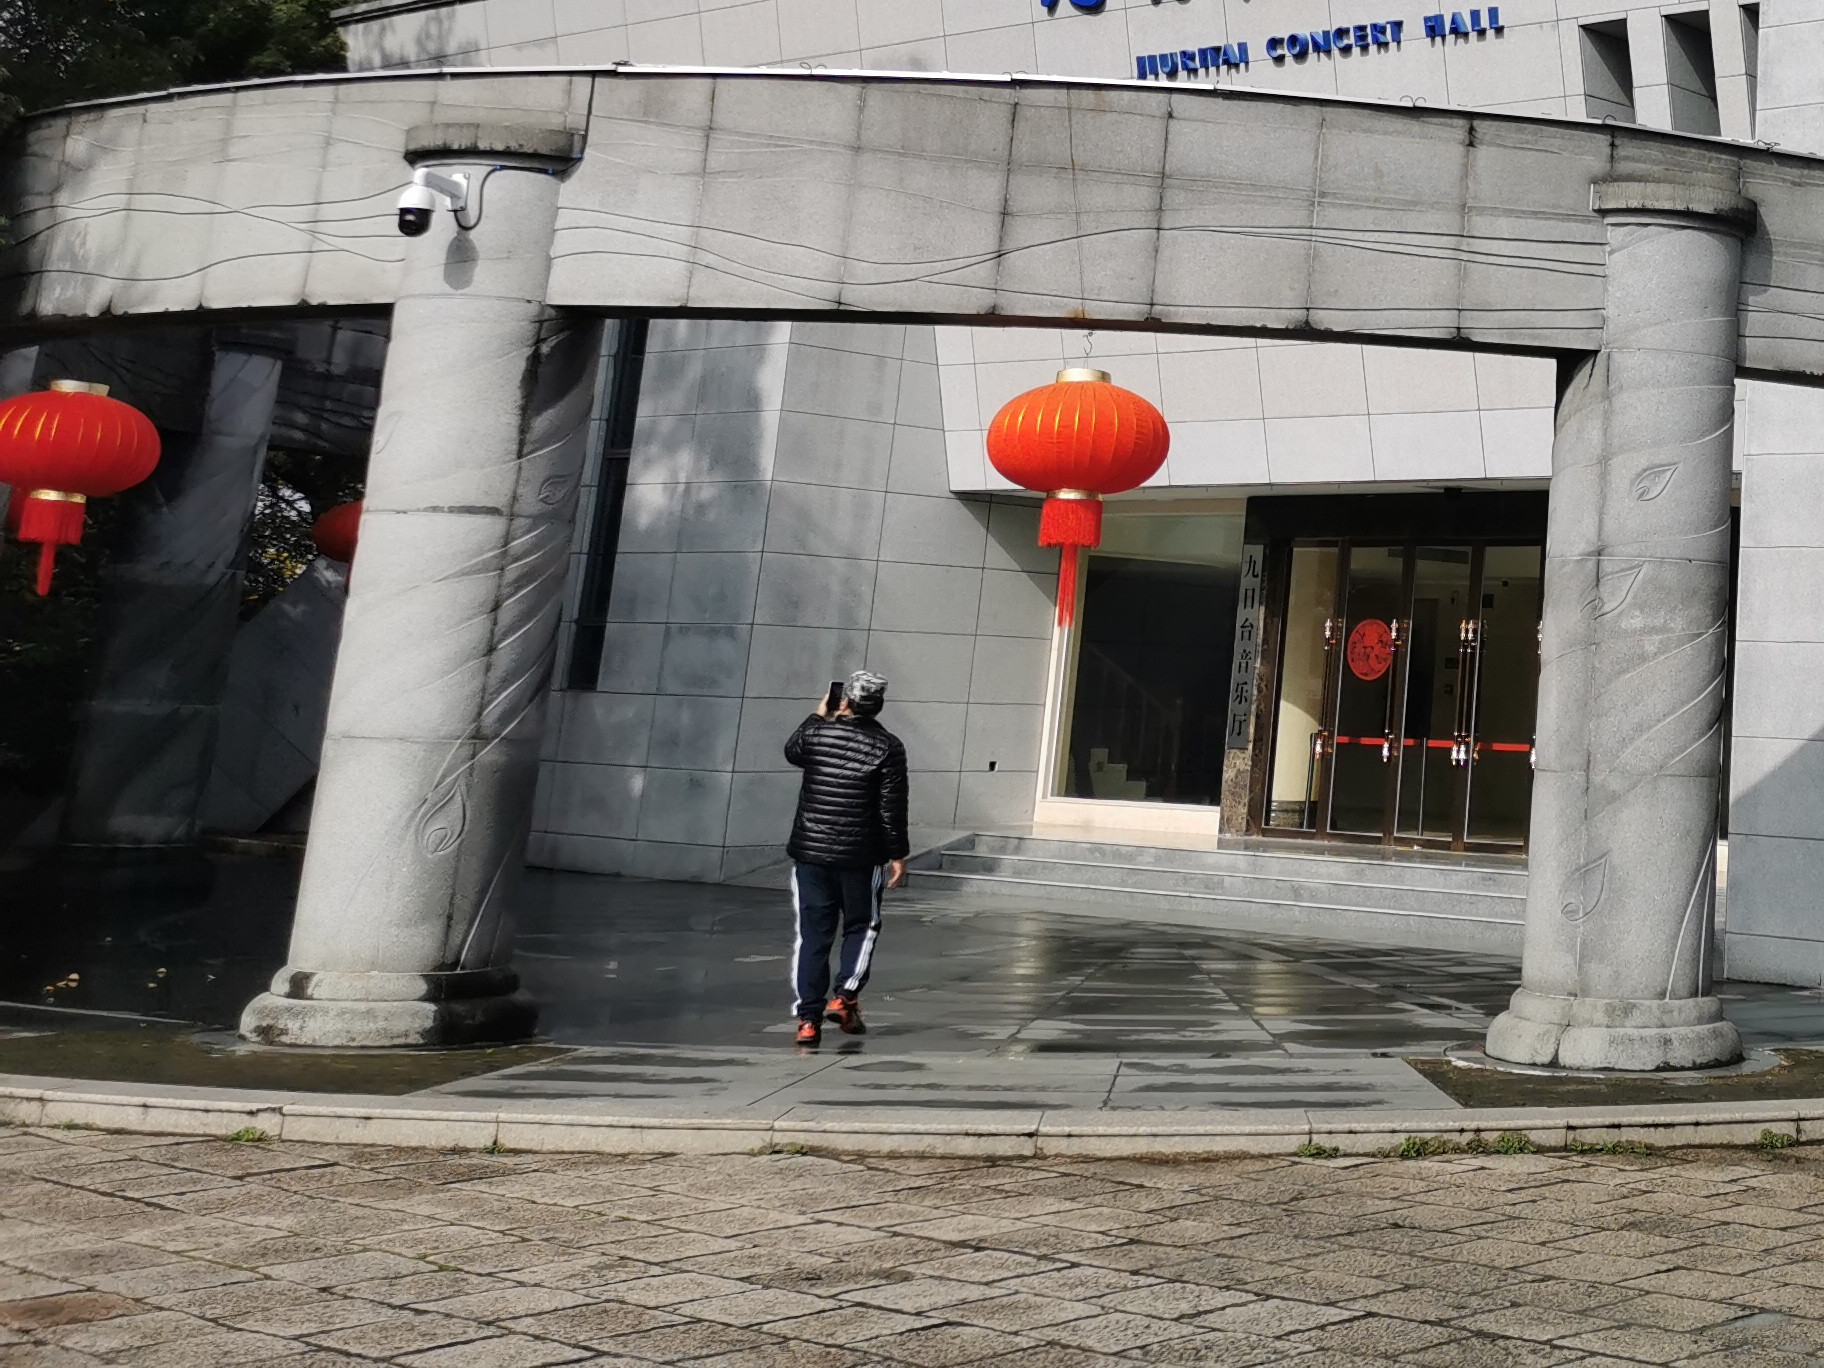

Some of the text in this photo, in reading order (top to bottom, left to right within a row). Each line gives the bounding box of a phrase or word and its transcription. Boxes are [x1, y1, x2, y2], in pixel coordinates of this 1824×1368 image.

[1266, 19, 1404, 61] CONCERT
[1424, 6, 1504, 40] HALL
[1230, 553, 1260, 738] 九日台音乐厅
